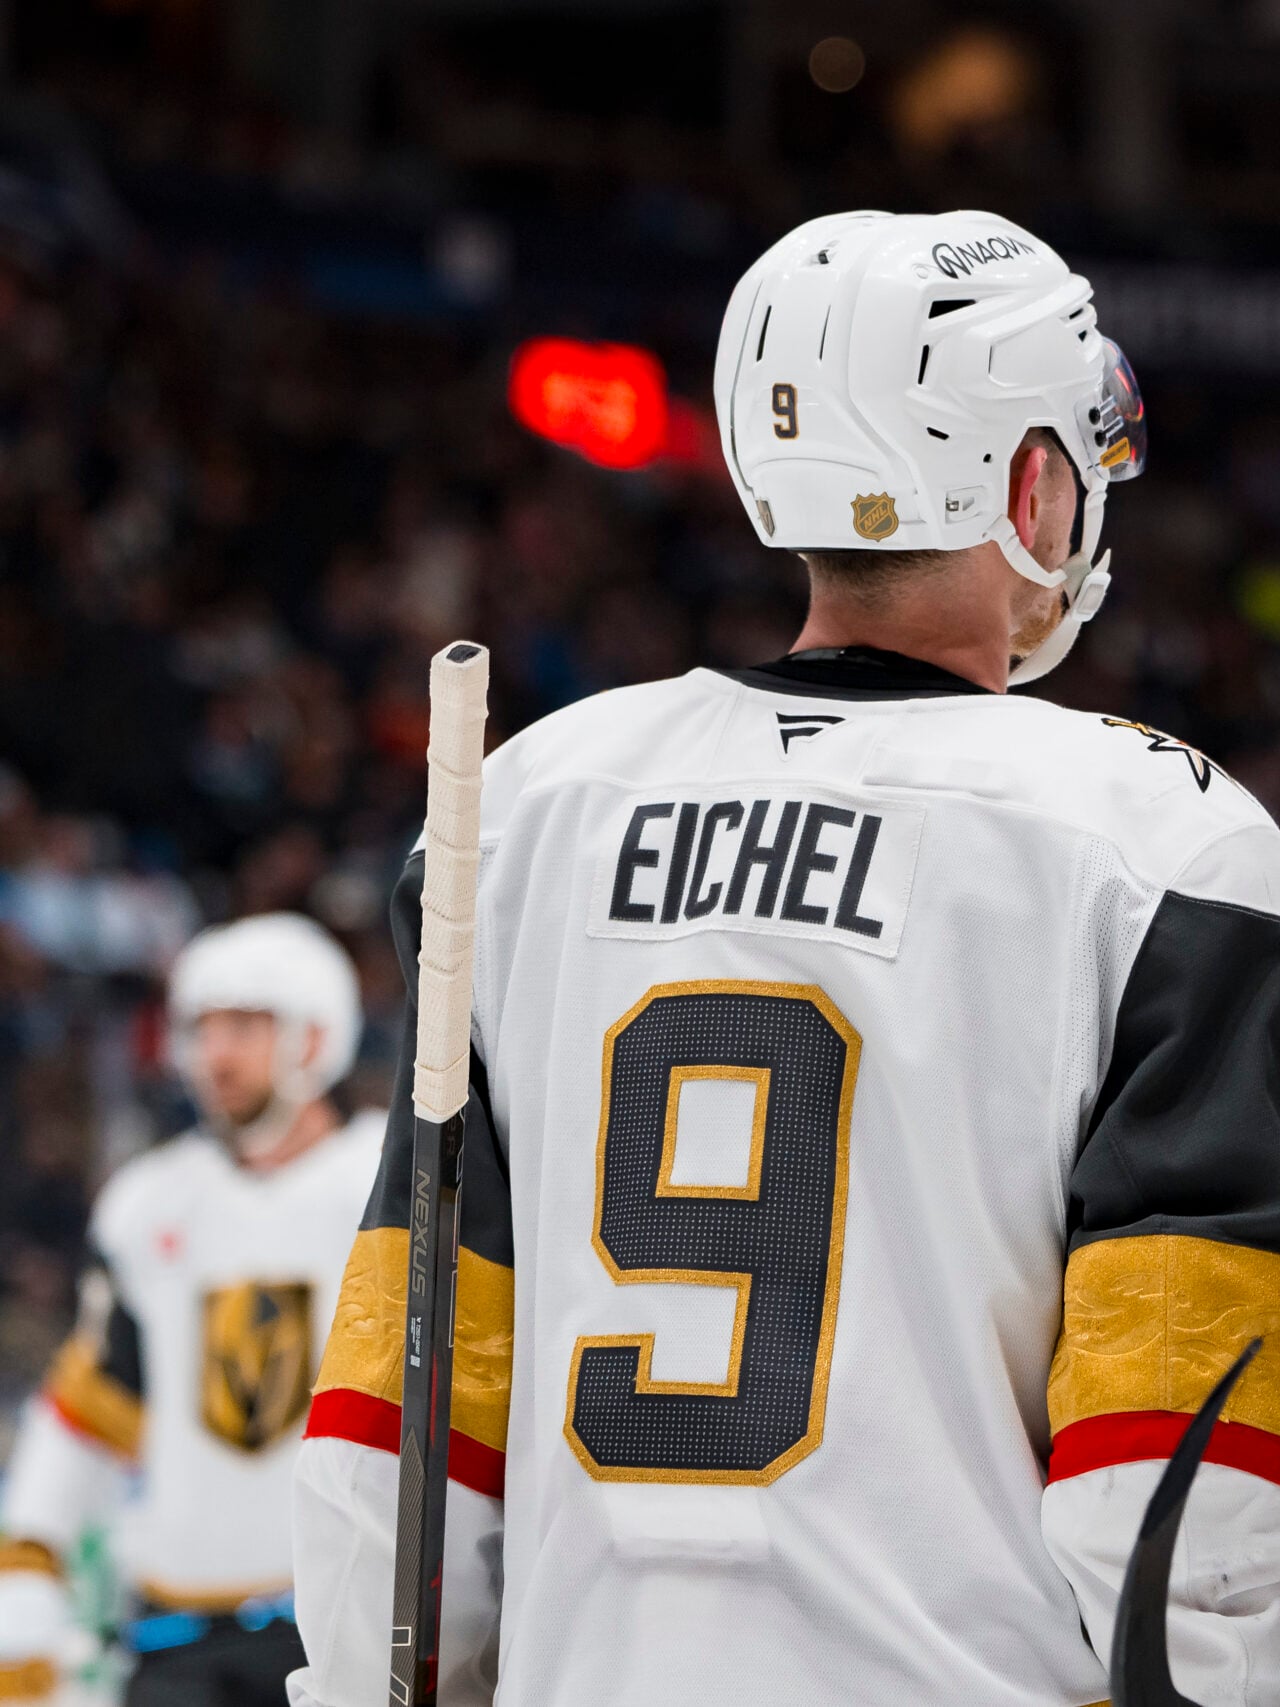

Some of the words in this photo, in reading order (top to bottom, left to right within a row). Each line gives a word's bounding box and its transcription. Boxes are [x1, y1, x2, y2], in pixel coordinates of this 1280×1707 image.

[772, 383, 800, 441] 9
[608, 799, 884, 940] EICHEL
[411, 1168, 432, 1298] NEXUS
[562, 979, 863, 1488] 9
